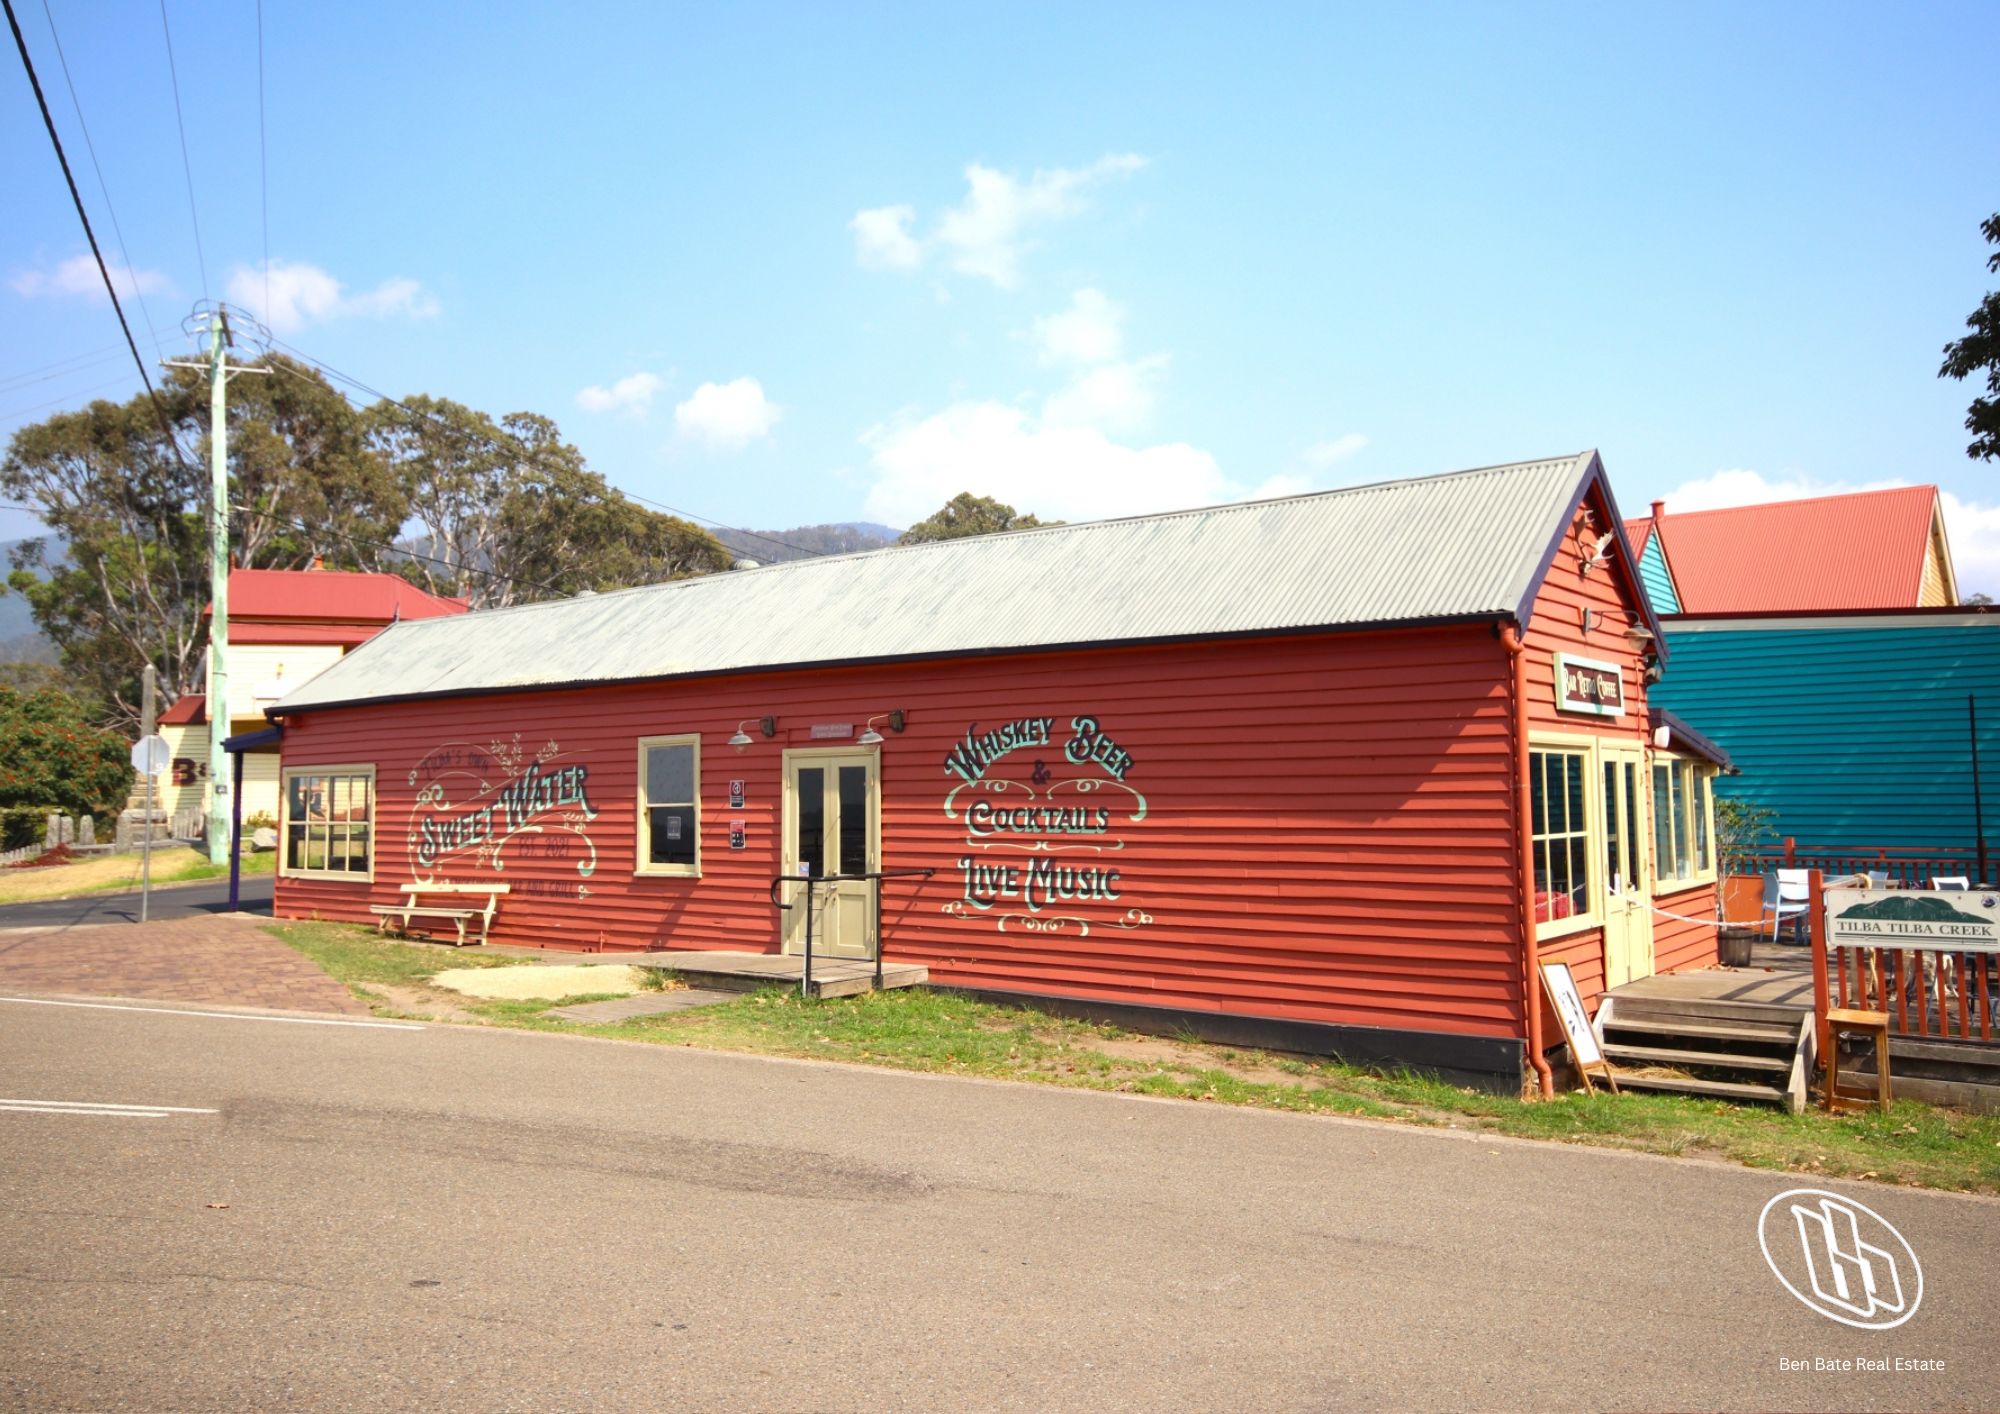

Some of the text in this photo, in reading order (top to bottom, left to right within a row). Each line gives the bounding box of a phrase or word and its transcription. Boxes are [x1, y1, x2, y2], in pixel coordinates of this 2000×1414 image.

[944, 714, 1135, 788] WHISKEY BEER
[1032, 759, 1051, 785] &
[417, 760, 599, 868] SWEET WATER
[964, 799, 1110, 837] COCKTAILS
[957, 854, 1121, 912] LIVE MUSIC
[1836, 921, 1993, 937] TILBA TILBA CREEK
